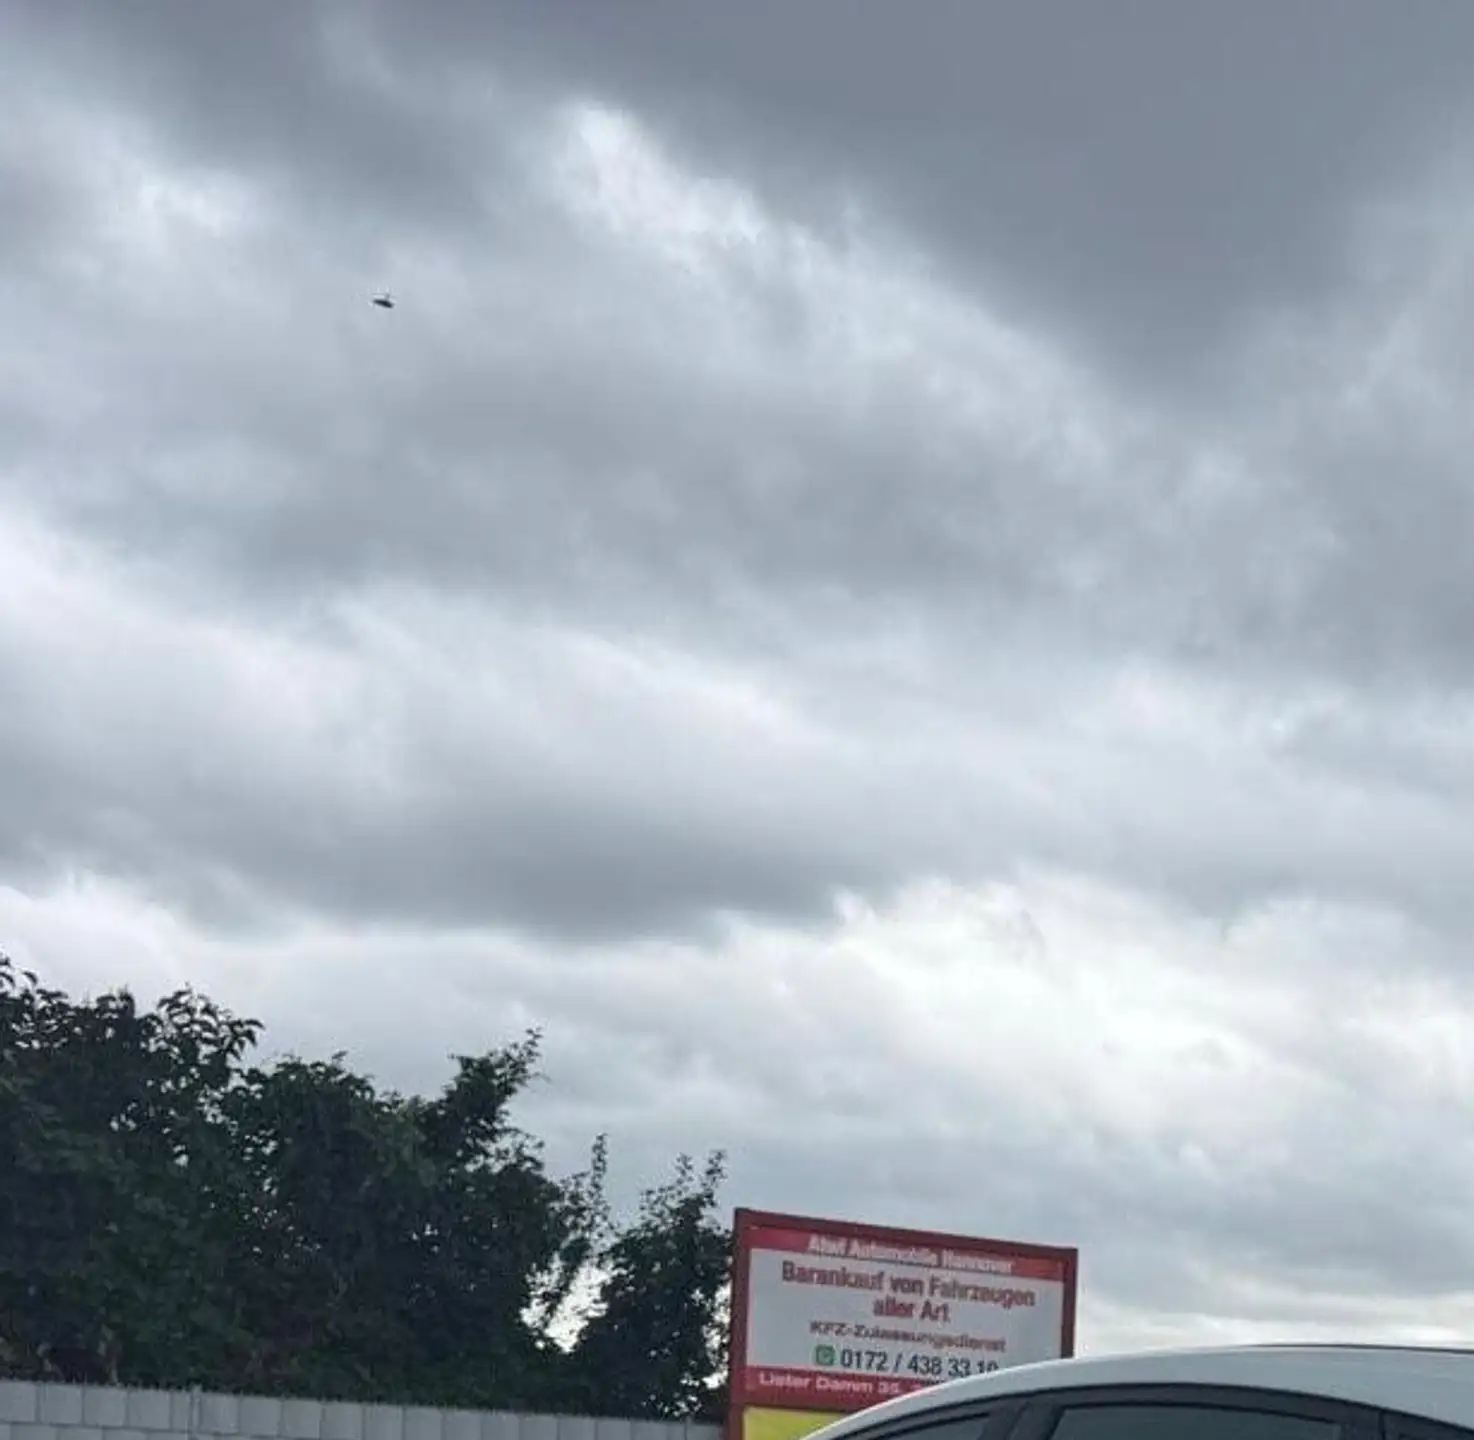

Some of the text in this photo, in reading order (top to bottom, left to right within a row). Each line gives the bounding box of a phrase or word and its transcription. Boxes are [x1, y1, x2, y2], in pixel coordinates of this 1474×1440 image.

[890, 1275, 923, 1297] von
[929, 1275, 1036, 1310] Fahrzeugen
[873, 1295, 950, 1323] aller Art
[840, 1348, 887, 1370] 0172
[907, 1352, 942, 1376] 438
